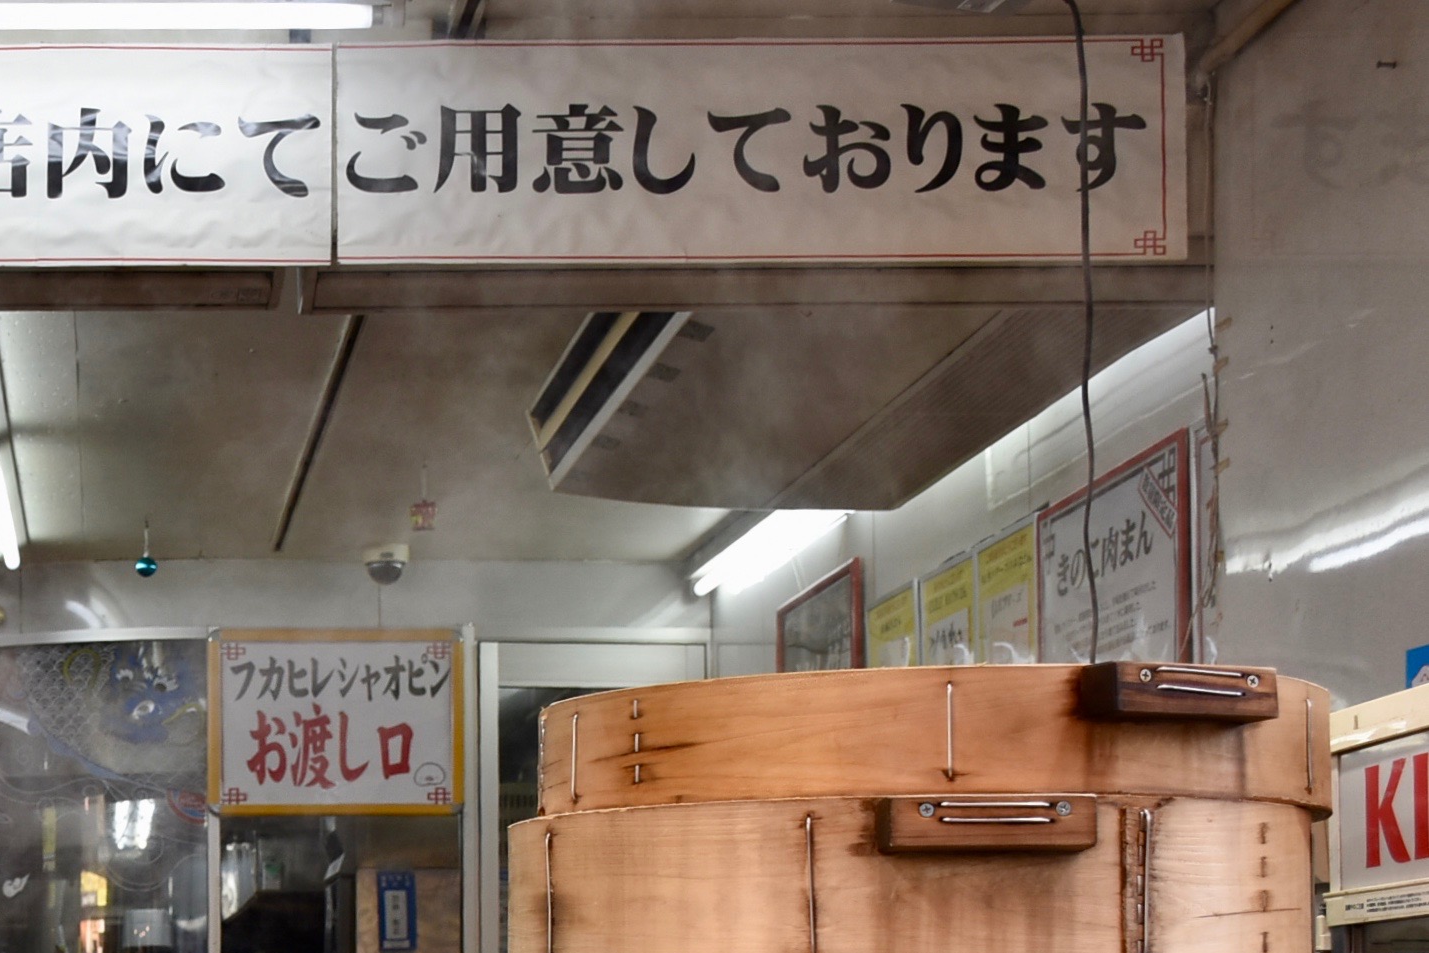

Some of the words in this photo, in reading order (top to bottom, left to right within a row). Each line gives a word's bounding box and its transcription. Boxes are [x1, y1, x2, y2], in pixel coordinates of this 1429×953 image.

[345, 102, 1147, 197] ご用意しております
[230, 653, 451, 702] フカヒレシャオピン
[247, 702, 414, 789] お渡し口
